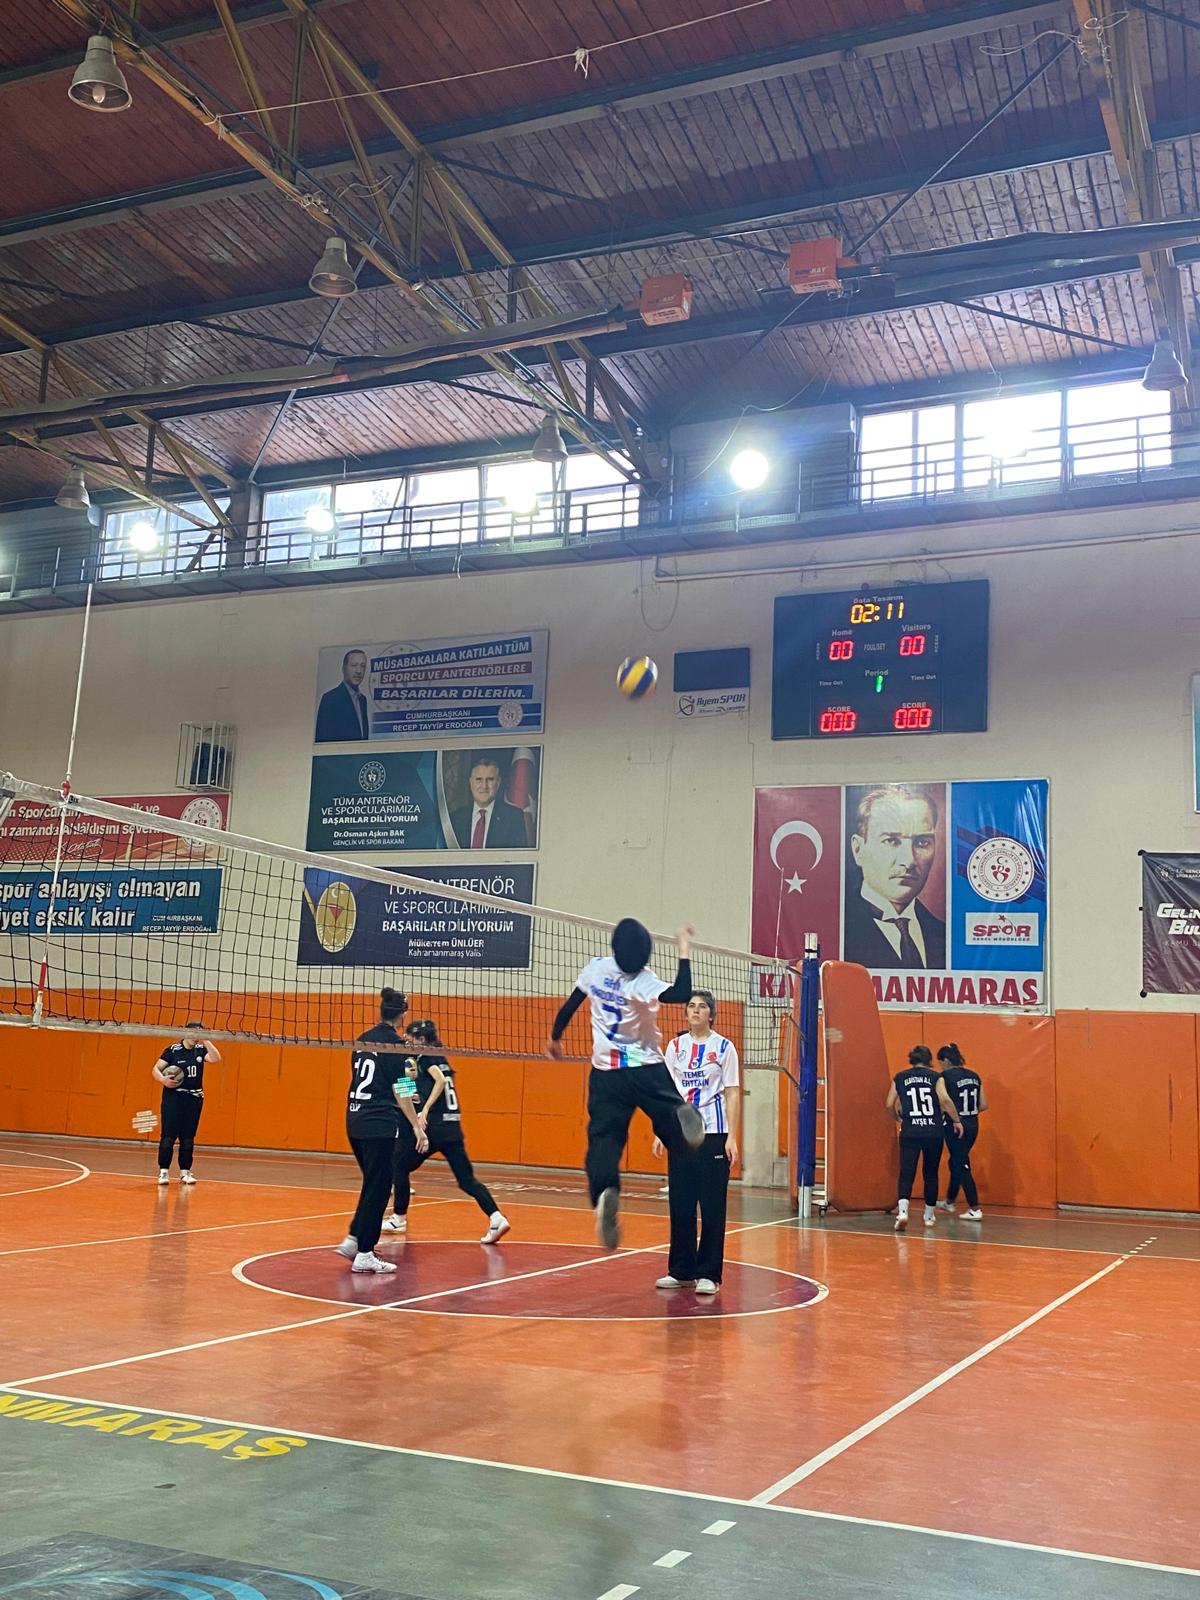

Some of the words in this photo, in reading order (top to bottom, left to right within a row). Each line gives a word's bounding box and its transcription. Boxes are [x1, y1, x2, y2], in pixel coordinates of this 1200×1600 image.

[850, 602, 905, 624] 02:11
[901, 624, 932, 632] Visitors
[829, 640, 854, 660] 00
[899, 635, 925, 655] 00
[373, 651, 457, 671] MÜSABAKALARA
[459, 645, 502, 660] KATILAN
[504, 640, 529, 654] TÜM
[382, 672, 425, 683] SPORCU
[427, 670, 441, 680] VE
[442, 664, 527, 678] ANTRENÖRLERE
[381, 688, 458, 699] BAŞARILAR
[461, 686, 526, 698] DİLERİM.
[876, 675, 883, 693] 1
[405, 710, 471, 719] CUMHURBAŞKANI
[820, 711, 856, 732] 000
[895, 708, 933, 728] 000
[392, 723, 418, 732] RECEP
[419, 722, 444, 731] TAYYİP
[445, 720, 483, 729] ERDOĞAN
[333, 796, 354, 806] TÜM
[356, 795, 410, 805] ANTRENÖR
[321, 807, 333, 815] VE
[335, 805, 421, 814] SPORCULARIMIZA
[322, 817, 369, 825] BAŞARILAR
[370, 815, 418, 823] DİLİYORUM
[9, 824, 60, 836] zamanda
[368, 830, 388, 838] Aşkın
[38, 879, 112, 903] anlayışı
[118, 878, 201, 901] olmayan
[429, 875, 515, 895] NTRENÖR
[384, 901, 400, 914] VE
[402, 900, 509, 914] SPORCULARIMIZ
[0, 907, 29, 930] yet
[382, 920, 446, 934] BAŞARILAR
[448, 918, 514, 932] DİLİYORUM
[187, 1065, 197, 1078] 10
[906, 1087, 935, 1116] 15
[959, 1088, 979, 1116] 11
[911, 1118, 928, 1127] AYŞE
